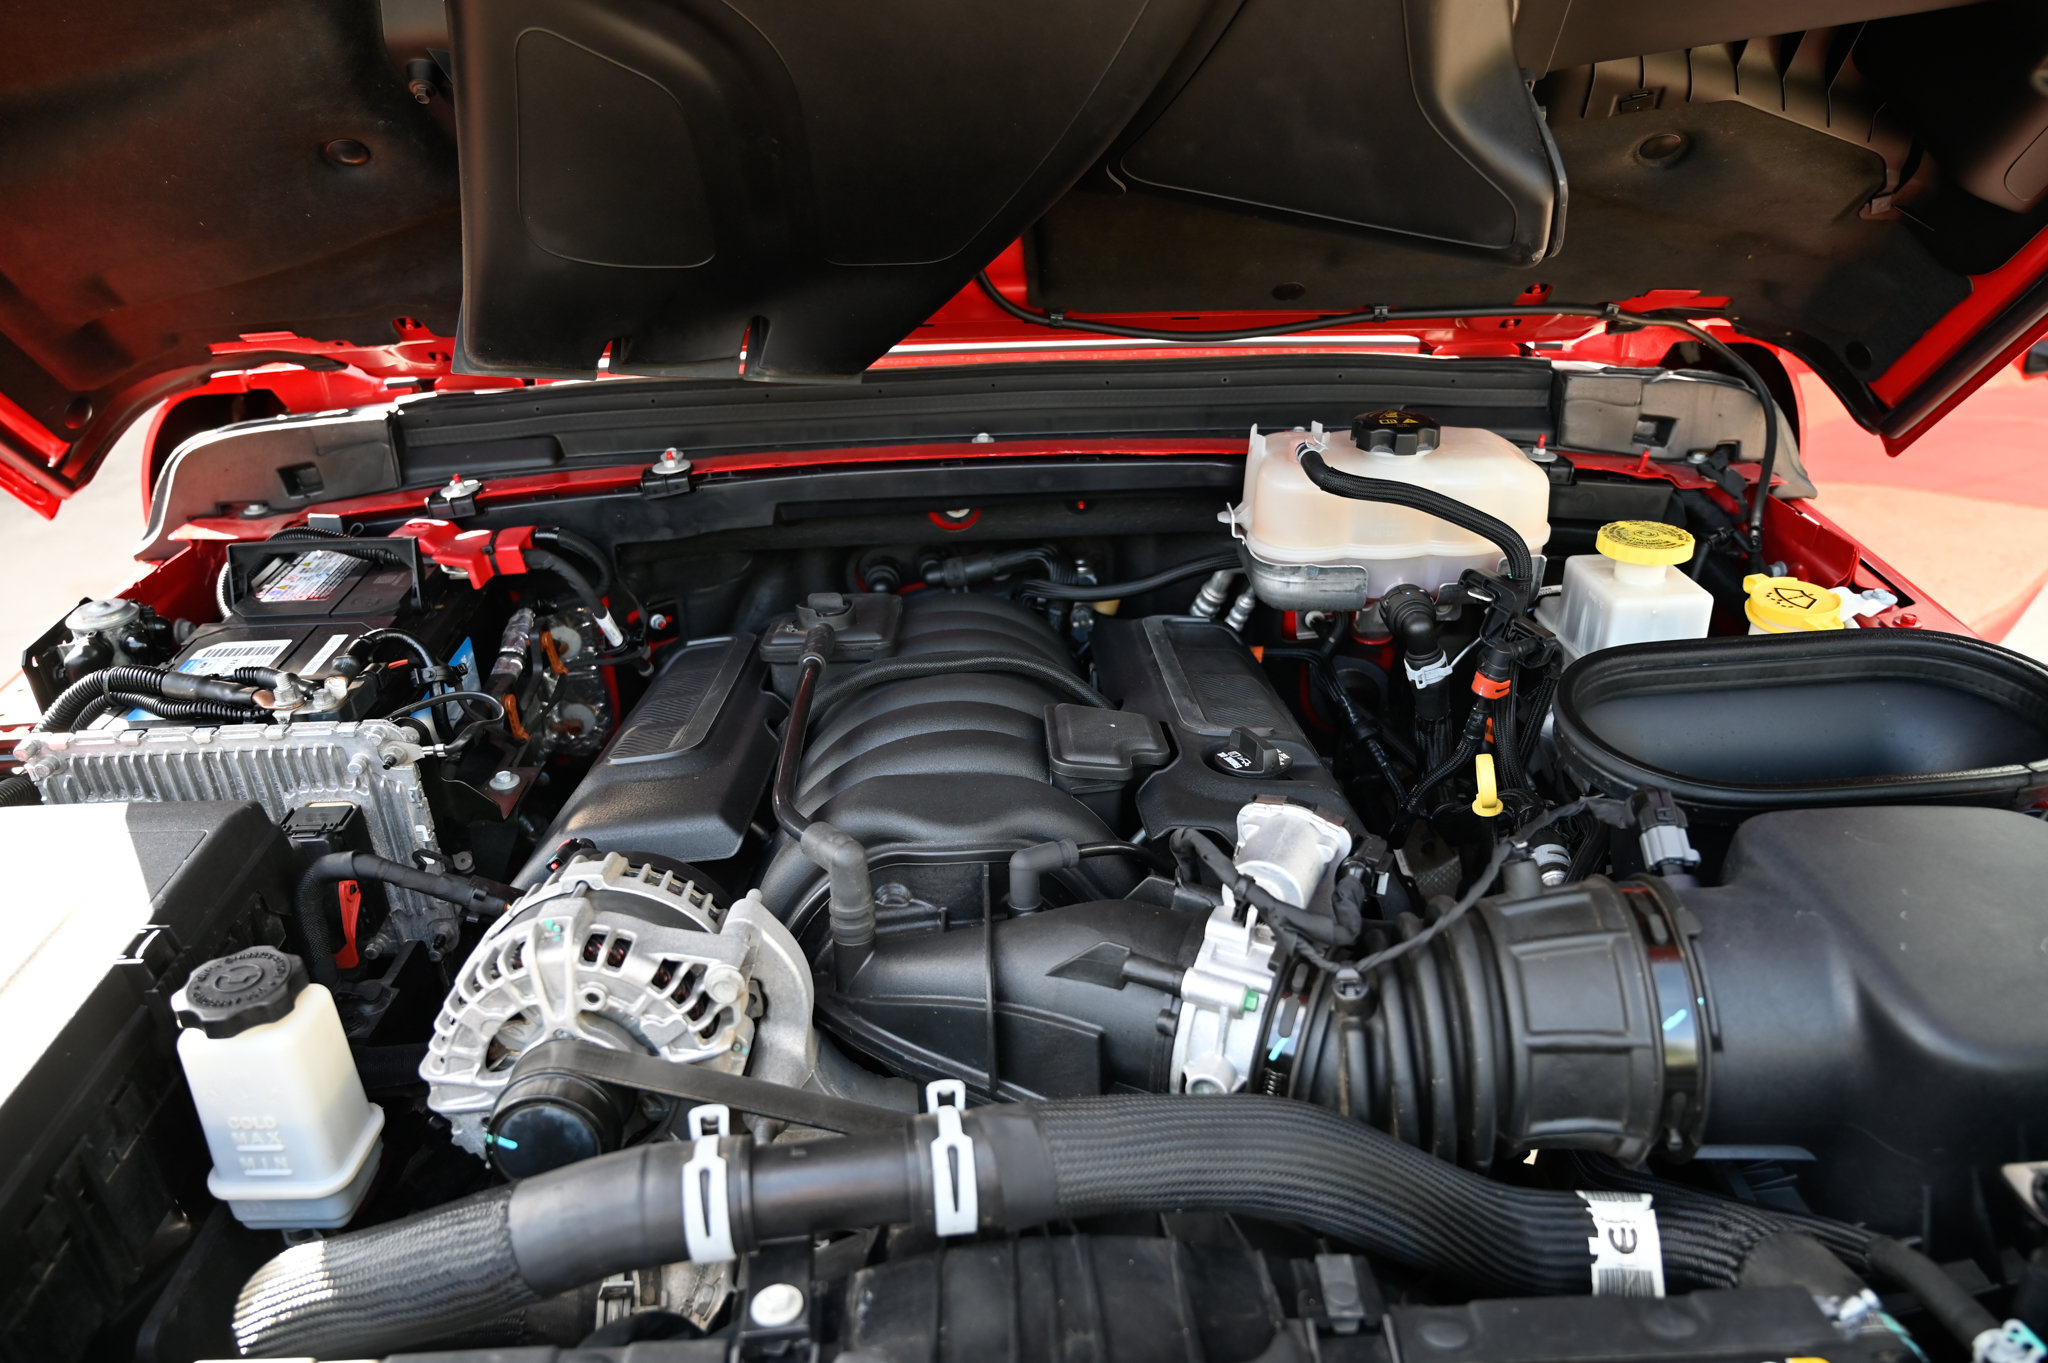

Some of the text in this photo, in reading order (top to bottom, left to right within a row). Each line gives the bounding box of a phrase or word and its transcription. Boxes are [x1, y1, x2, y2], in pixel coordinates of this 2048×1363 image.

[228, 1115, 277, 1130] COLD
[231, 1131, 282, 1145] MAX
[239, 1156, 289, 1170] MIN
